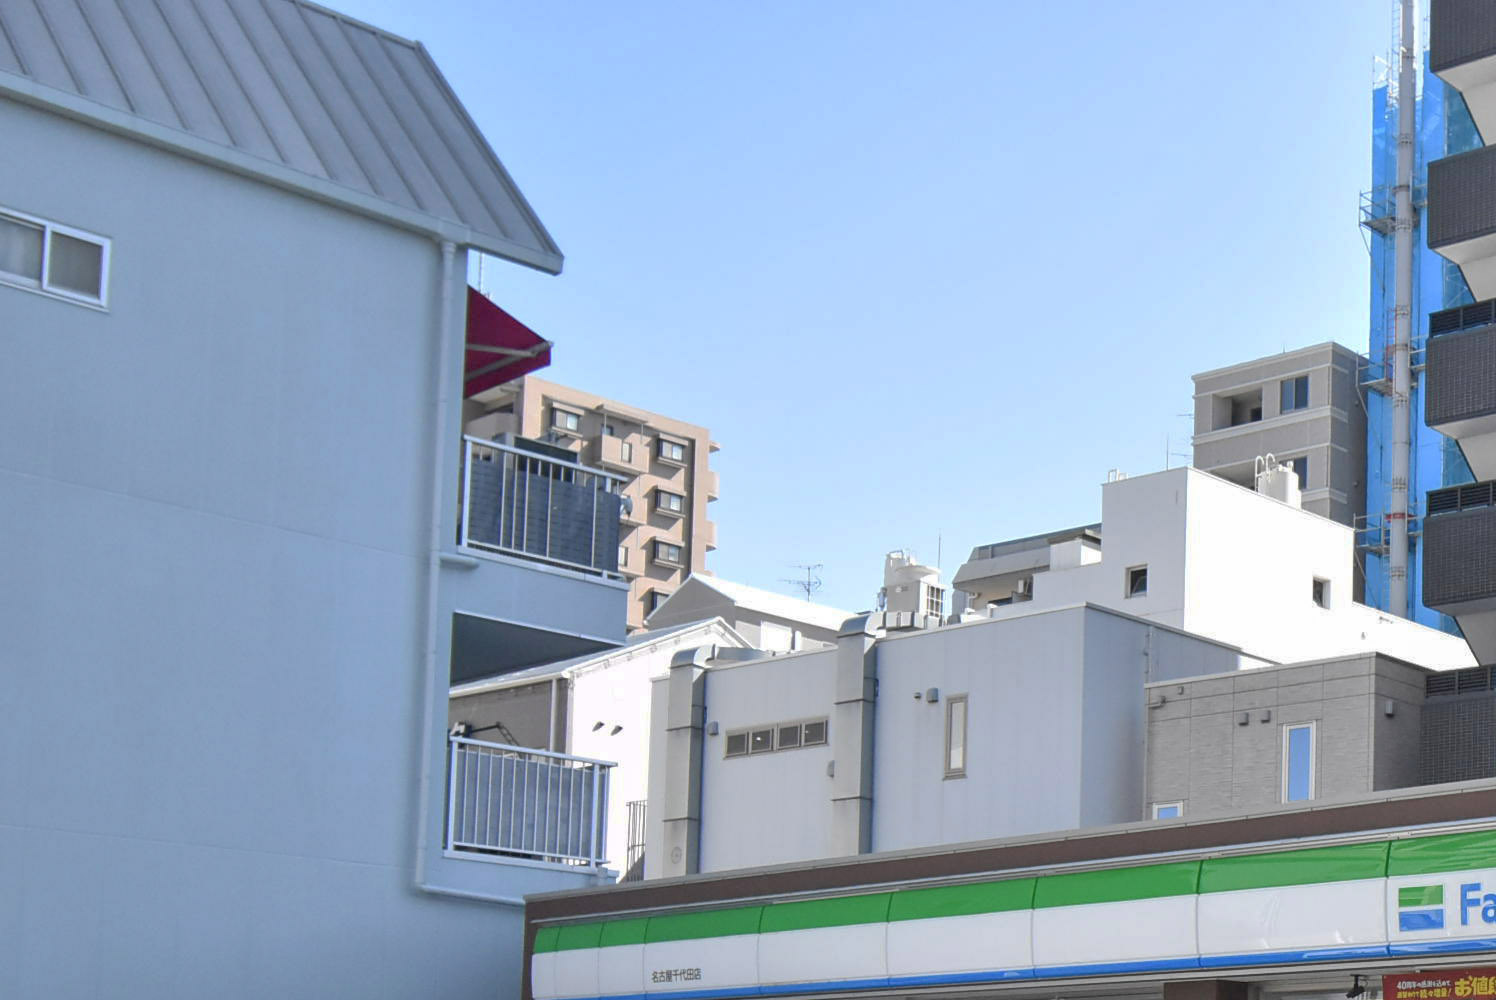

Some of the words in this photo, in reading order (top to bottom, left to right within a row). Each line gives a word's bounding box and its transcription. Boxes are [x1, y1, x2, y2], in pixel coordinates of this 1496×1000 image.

[651, 967, 702, 984] 名古屋千代田店
